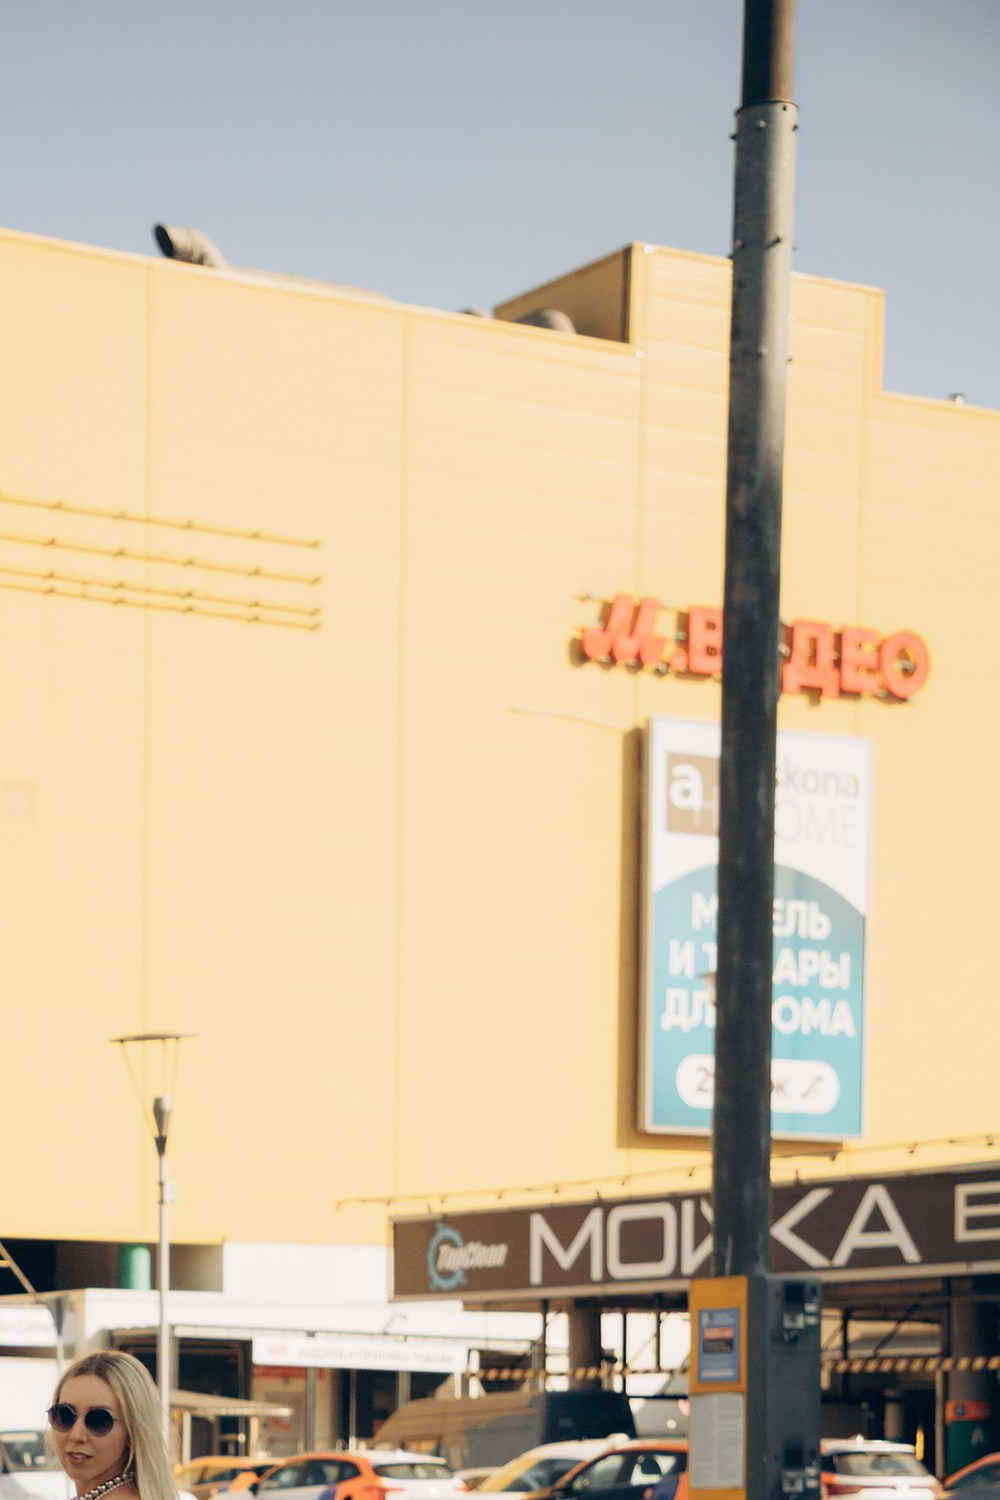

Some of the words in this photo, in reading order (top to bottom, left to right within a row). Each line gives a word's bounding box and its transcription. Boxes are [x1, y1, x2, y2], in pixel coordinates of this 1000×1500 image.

[583, 594, 929, 698] М.ВДЕО
[692, 891, 832, 940] МЕЛЬ
[669, 939, 695, 979] И
[702, 941, 850, 989] ТАРЫ
[661, 987, 716, 1034] ДЛ
[771, 995, 856, 1037] ОМА
